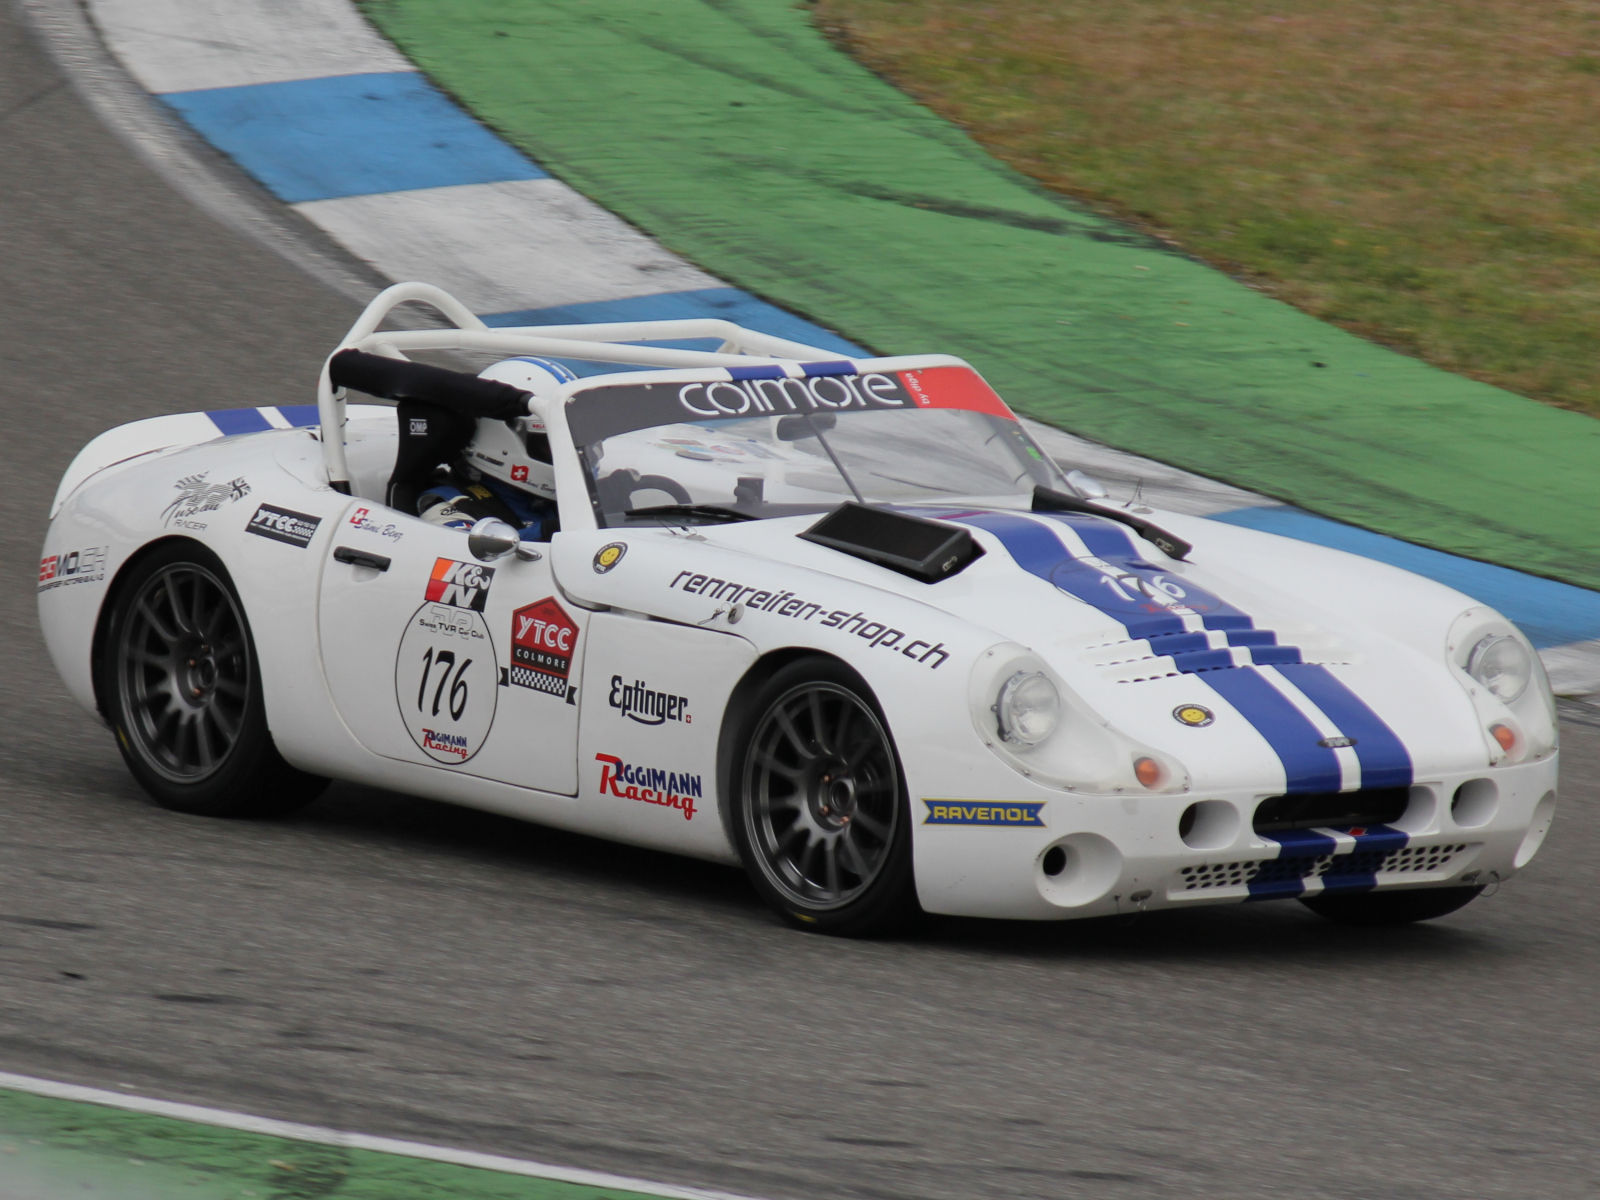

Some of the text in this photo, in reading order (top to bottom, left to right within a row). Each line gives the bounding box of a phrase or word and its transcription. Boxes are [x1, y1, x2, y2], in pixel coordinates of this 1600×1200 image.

[678, 373, 904, 417] colmore
[409, 421, 428, 433] OMP
[173, 518, 208, 532] RACER
[252, 508, 299, 533] YTCC
[1101, 574, 1187, 602] 176
[438, 622, 457, 633] TVR
[669, 568, 952, 670] rennreifen-shop.ch
[515, 615, 572, 652] YTCC
[516, 648, 566, 669] COLMORE
[417, 645, 473, 722] 176
[608, 674, 688, 723] Eptinger
[595, 752, 698, 821] Racing
[933, 806, 1036, 822] RAVENOL
